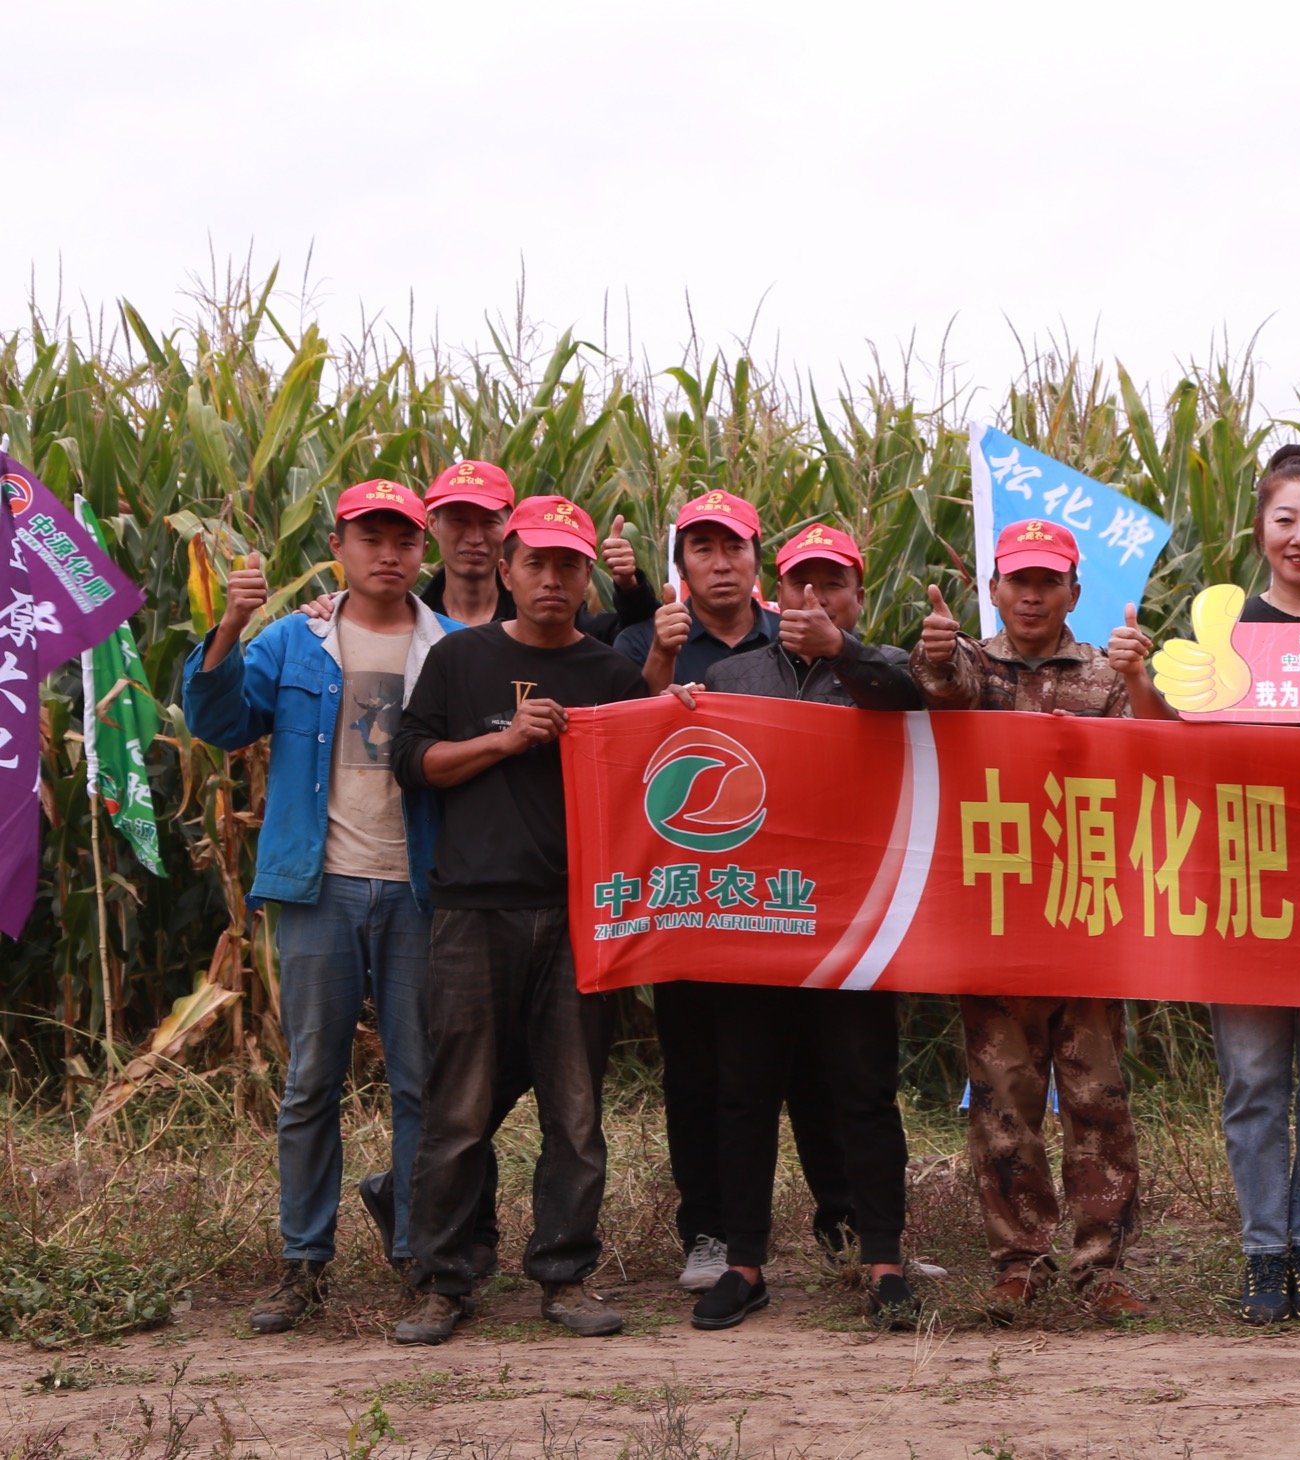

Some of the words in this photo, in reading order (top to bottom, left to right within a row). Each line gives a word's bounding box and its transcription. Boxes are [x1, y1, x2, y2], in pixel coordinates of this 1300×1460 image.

[448, 475, 485, 487] 中源农业
[366, 491, 405, 505] 中源农业
[696, 503, 732, 514] 中源农业
[989, 446, 1155, 567] 松化牌
[544, 512, 580, 530] 中源农业
[796, 535, 834, 549] 中源农业
[1017, 531, 1054, 543] 中源农业
[28, 512, 116, 607] 中源化肥
[594, 863, 816, 918] 中源农业
[594, 917, 650, 940] ZHONG
[654, 912, 702, 930] YUAN
